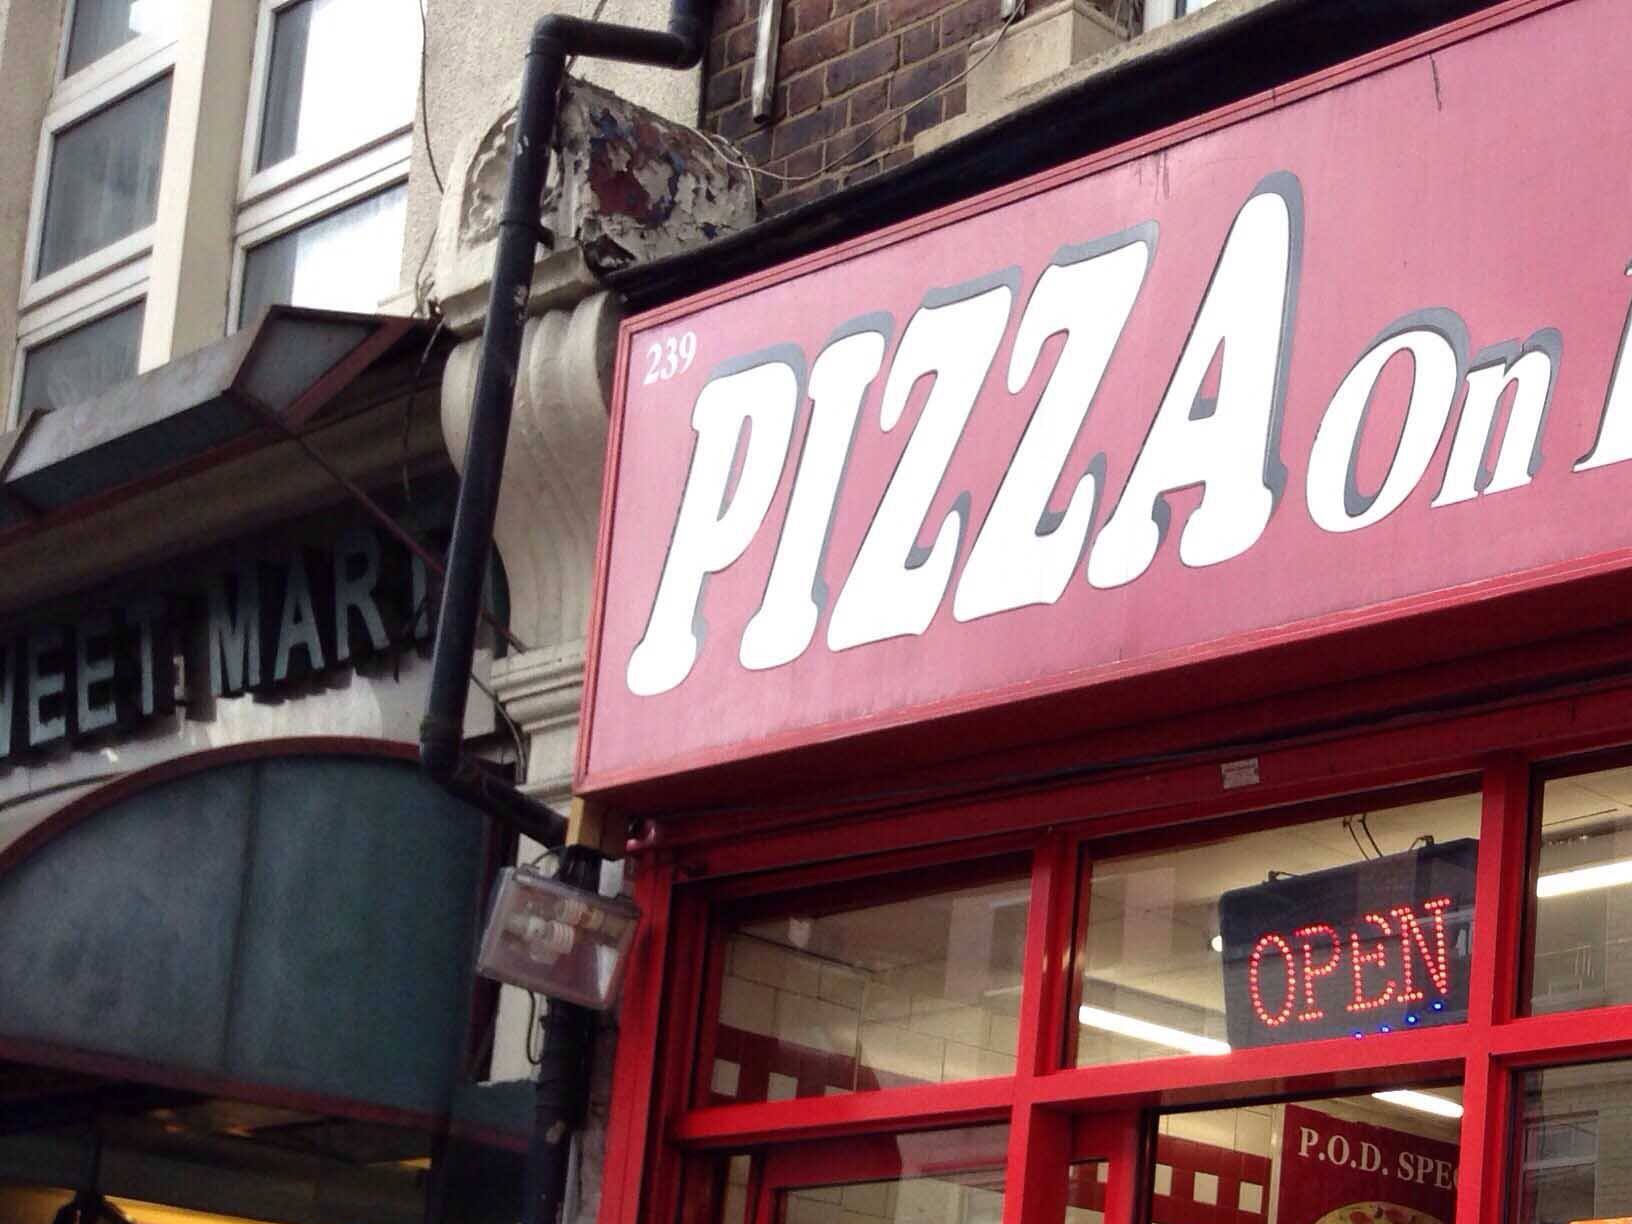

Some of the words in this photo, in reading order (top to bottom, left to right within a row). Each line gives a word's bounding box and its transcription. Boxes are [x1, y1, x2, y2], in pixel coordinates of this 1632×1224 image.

[643, 331, 698, 387] 239
[626, 176, 1300, 697] PIZZA
[1305, 310, 1561, 534] On
[0, 594, 165, 758] EET
[1248, 895, 1452, 1028] OPEN
[1297, 1126, 1389, 1176] P.O.D.
[1397, 1151, 1459, 1191] SPE
